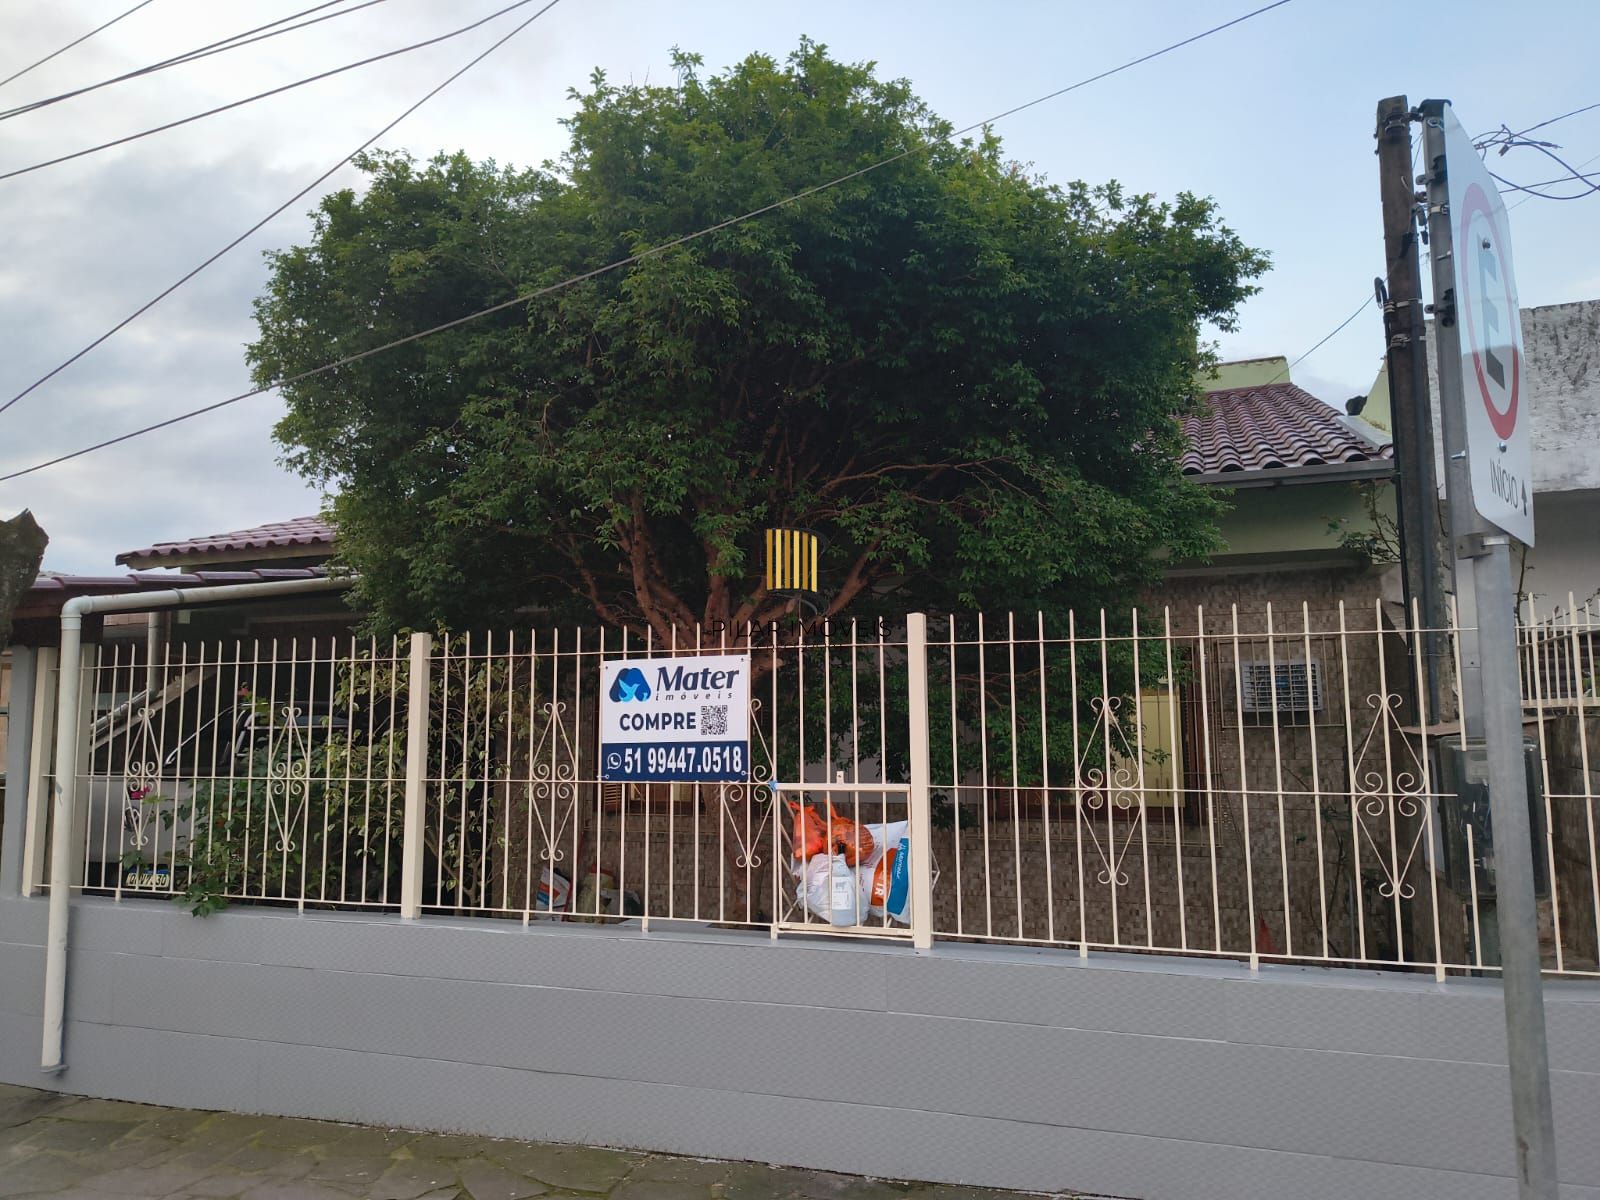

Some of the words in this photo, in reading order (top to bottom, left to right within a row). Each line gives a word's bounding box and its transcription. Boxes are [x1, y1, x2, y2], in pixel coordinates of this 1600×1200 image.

[1489, 457, 1518, 509] INÍCIO
[657, 665, 740, 692] Mater
[655, 690, 733, 701] imóveis
[619, 711, 697, 732] COMPRE
[624, 747, 642, 774] 51
[647, 745, 742, 774] 99447.0518
